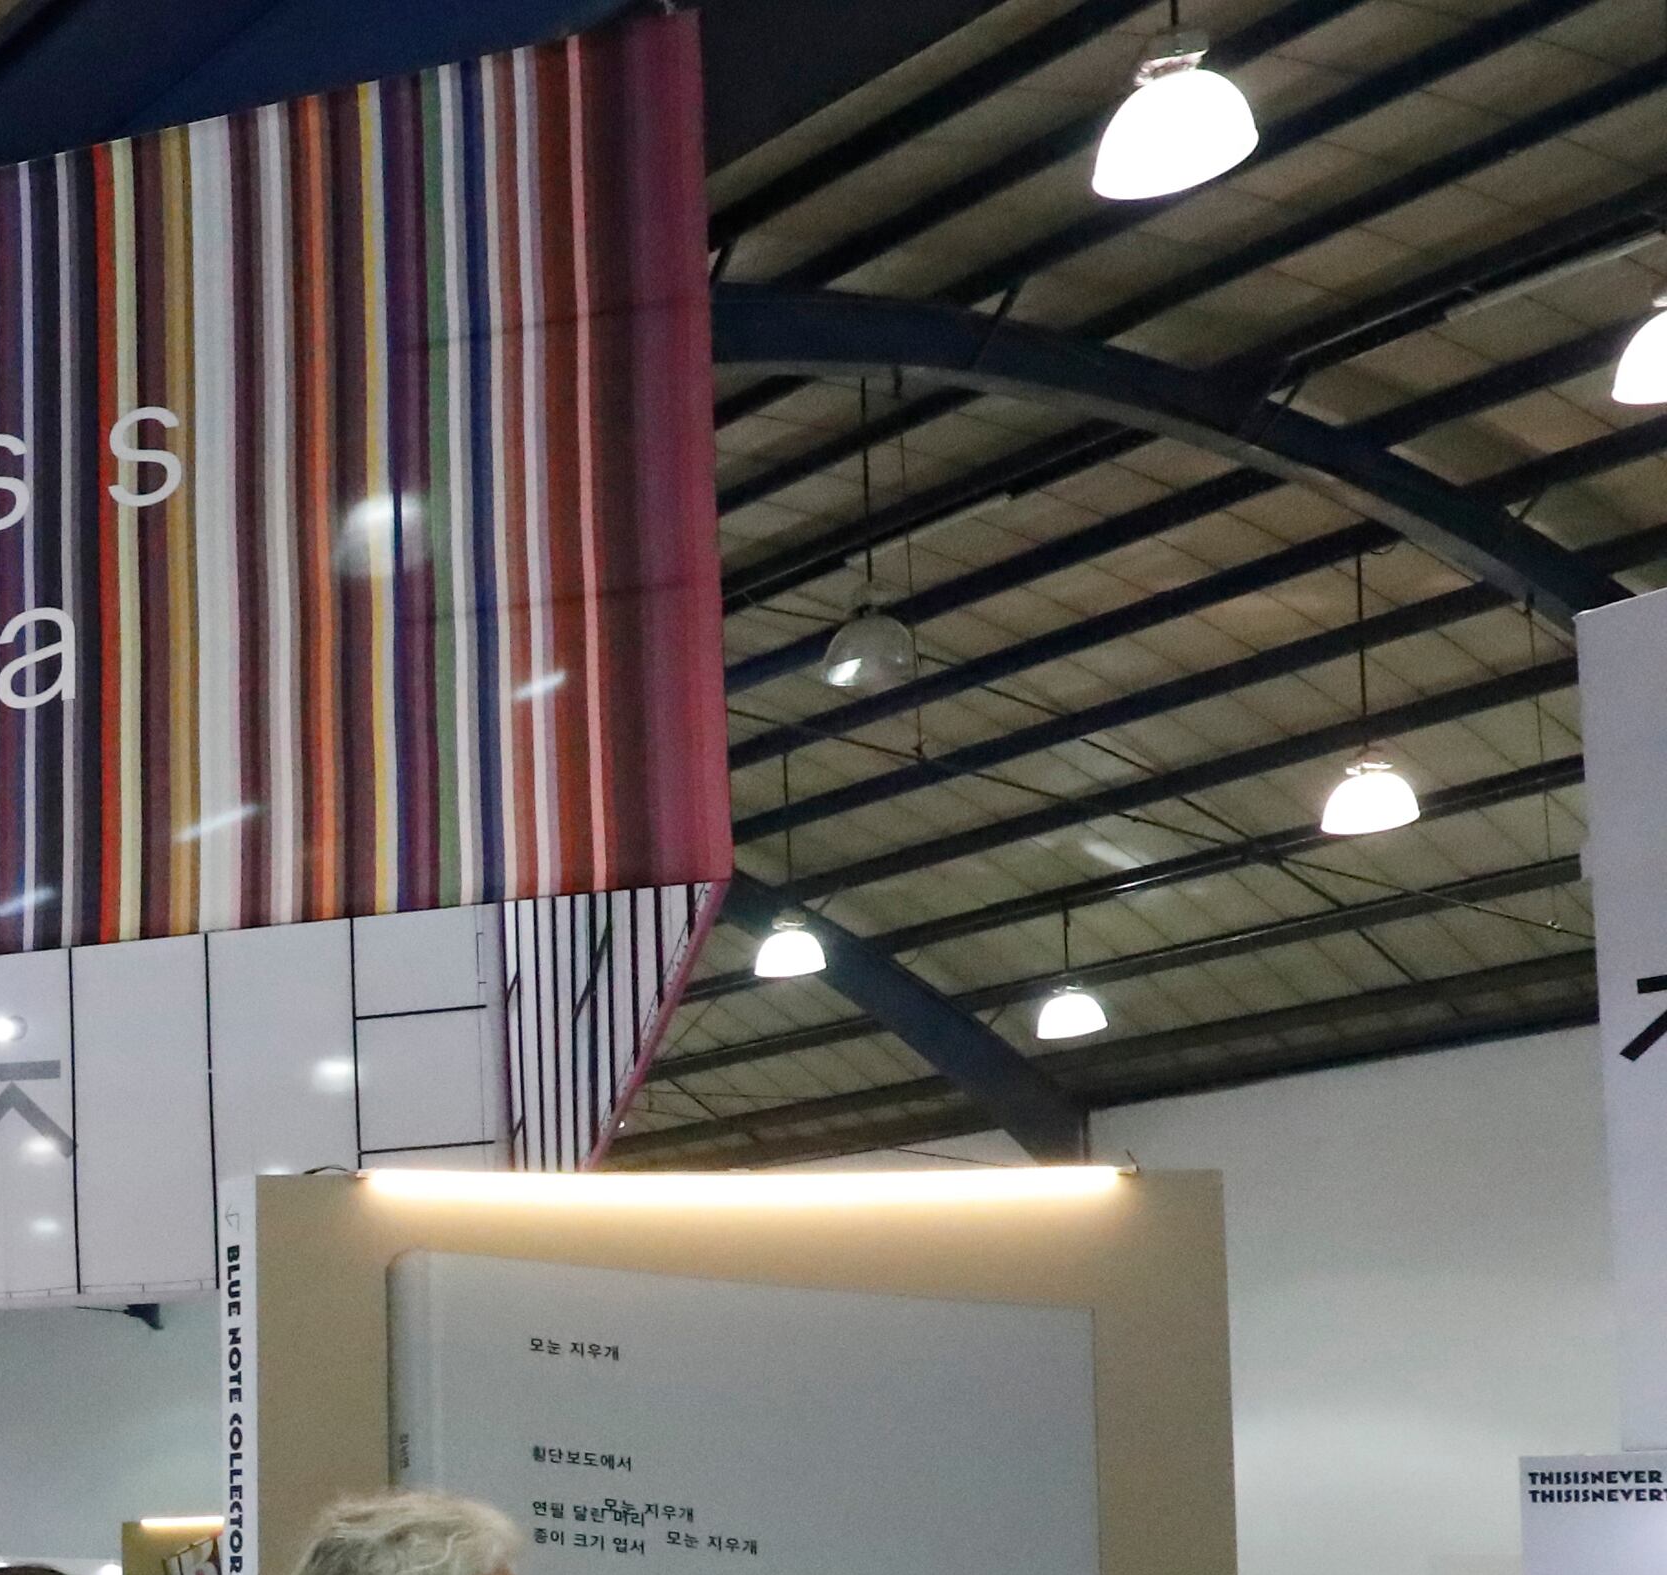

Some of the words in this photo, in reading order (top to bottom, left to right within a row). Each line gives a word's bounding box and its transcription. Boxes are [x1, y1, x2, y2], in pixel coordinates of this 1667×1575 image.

[227, 1244, 242, 1318] BLUE
[569, 1341, 620, 1362] 지우개
[227, 1326, 243, 1404] NOTE
[1528, 1470, 1664, 1485] THISISNEVER
[573, 1533, 606, 1551] 크기
[707, 1535, 759, 1556] 지우개
